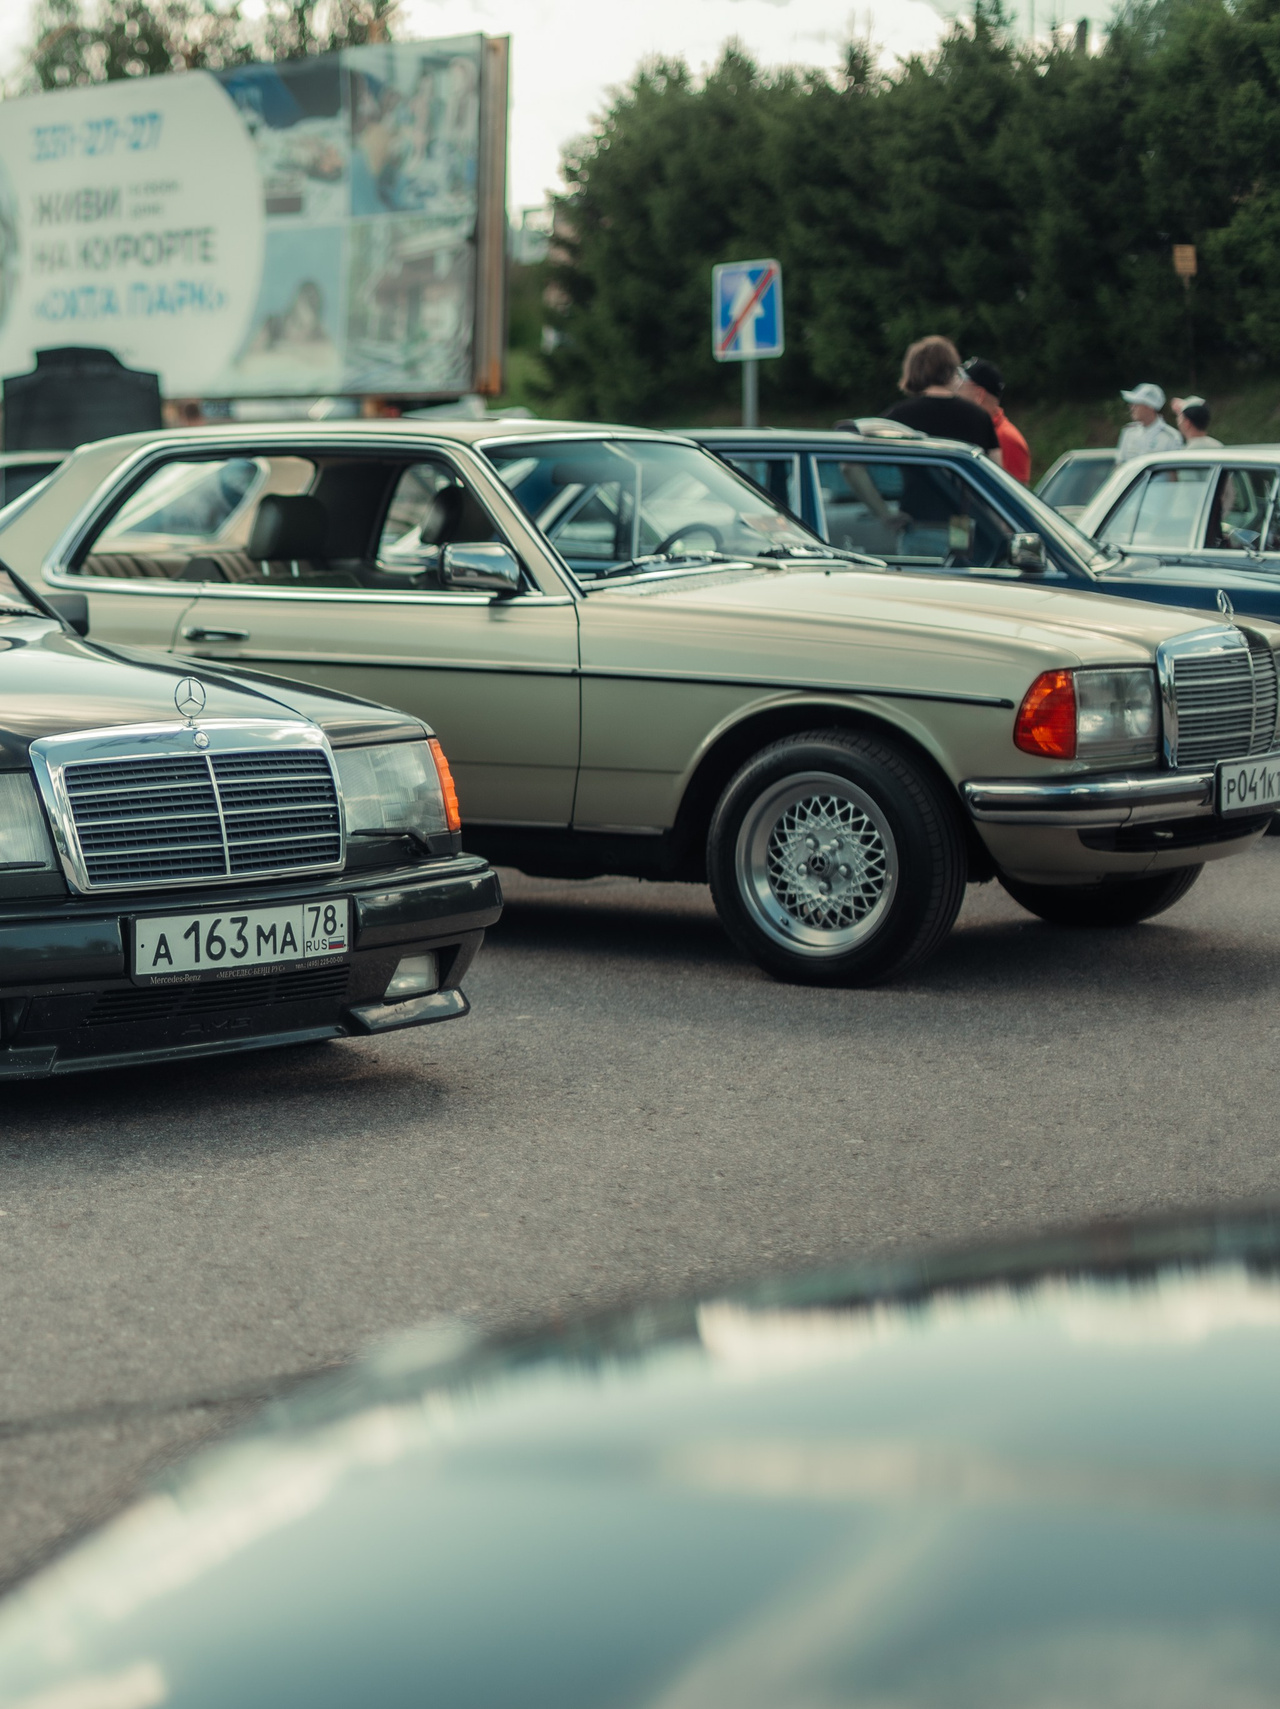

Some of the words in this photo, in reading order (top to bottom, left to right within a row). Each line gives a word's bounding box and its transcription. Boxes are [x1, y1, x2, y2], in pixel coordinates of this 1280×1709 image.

[32, 187, 122, 226] ЖИВИ
[32, 242, 69, 273] НА
[75, 226, 216, 270] КУРОРТЕ
[307, 904, 337, 938] 78
[305, 938, 328, 952] RUS
[150, 974, 202, 985] Mercedes-Benz
